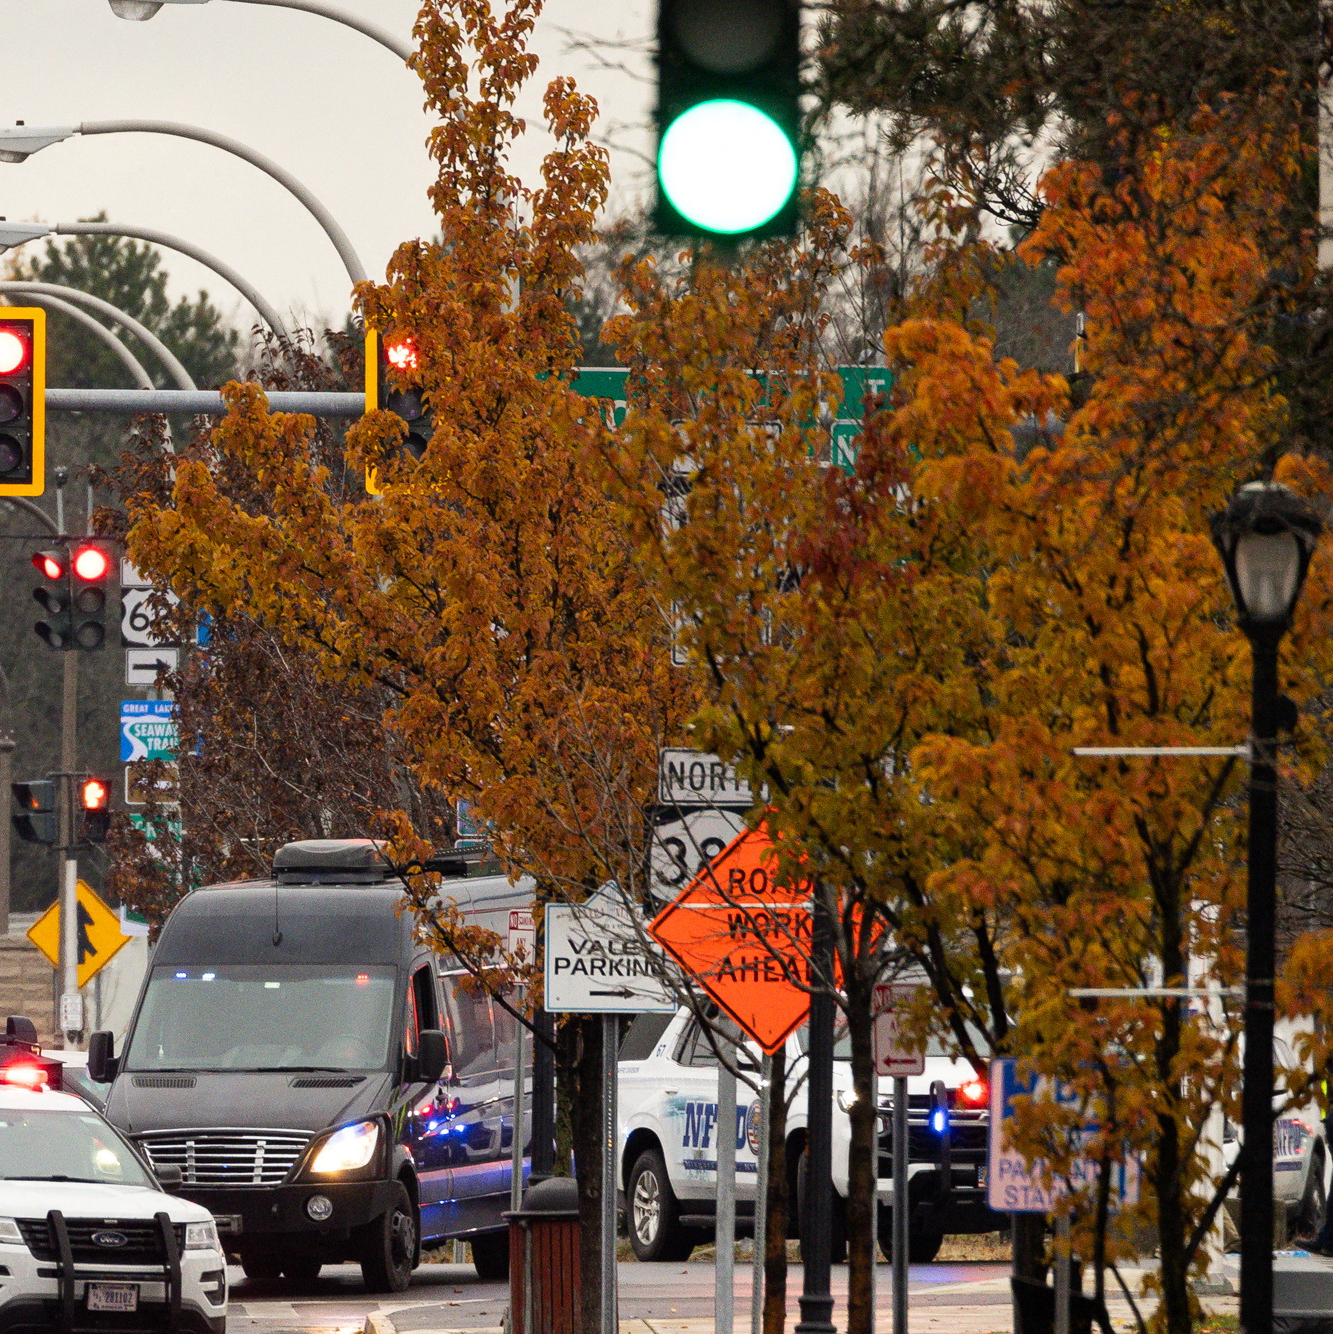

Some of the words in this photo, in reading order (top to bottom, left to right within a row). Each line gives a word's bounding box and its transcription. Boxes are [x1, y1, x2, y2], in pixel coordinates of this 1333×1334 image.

[123, 704, 148, 713] GREAT
[134, 724, 179, 737] SEAWAY
[728, 912, 812, 939] WORK
[554, 957, 671, 977] PARKIN
[717, 956, 812, 983] AHEA
[683, 1103, 748, 1149] NFD
